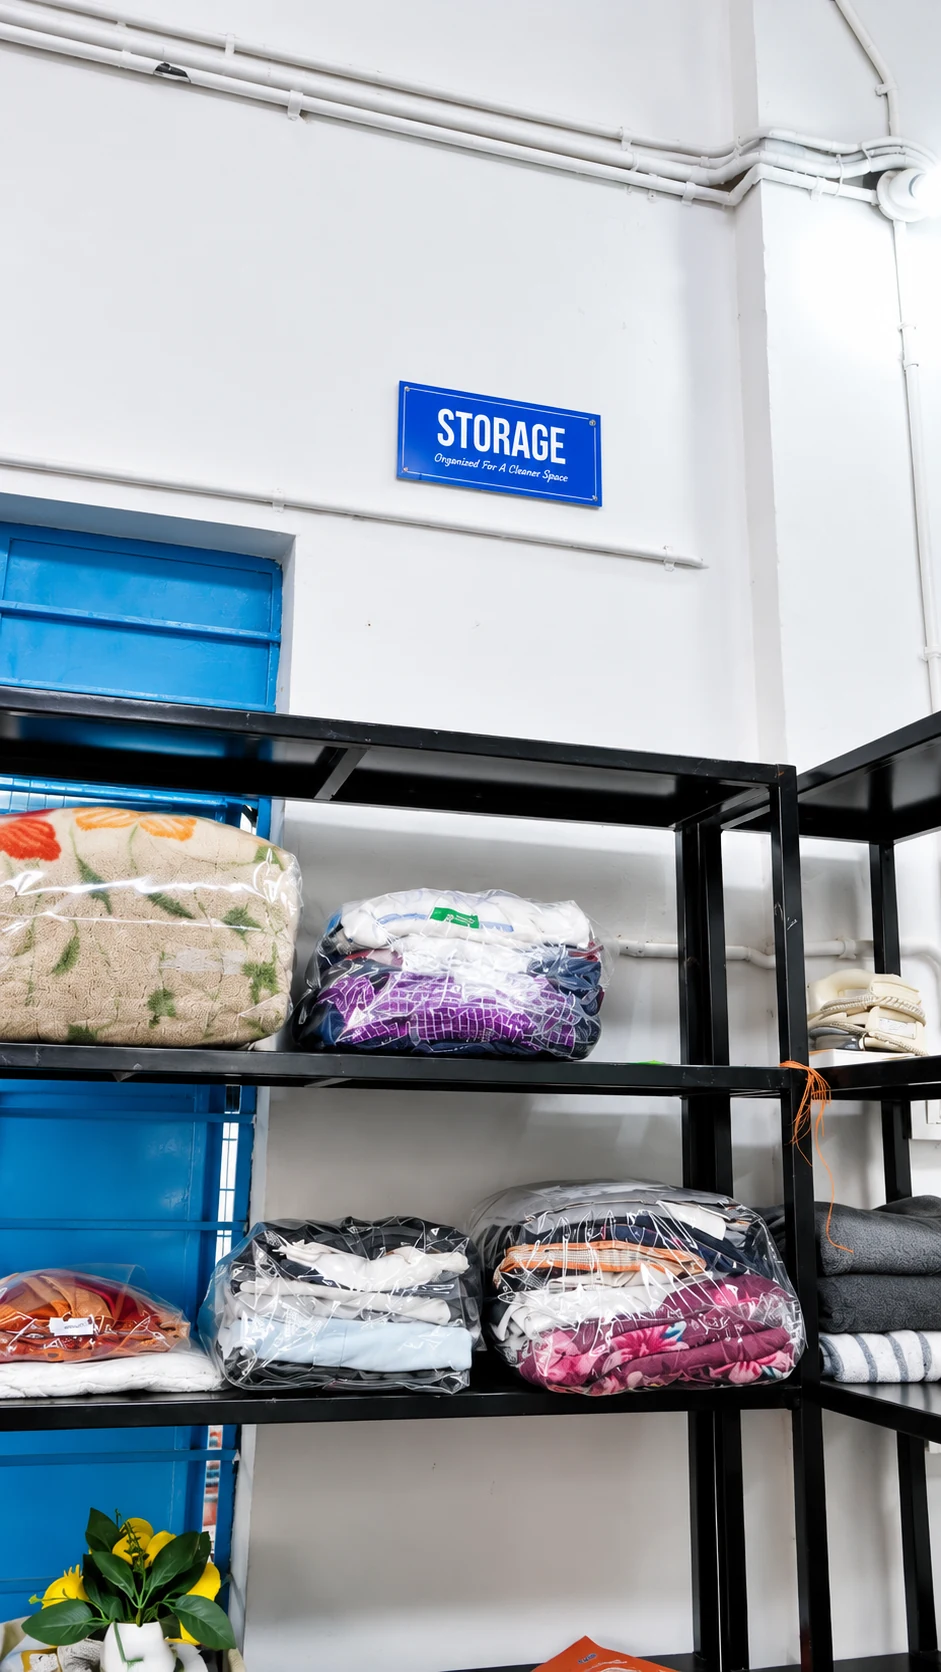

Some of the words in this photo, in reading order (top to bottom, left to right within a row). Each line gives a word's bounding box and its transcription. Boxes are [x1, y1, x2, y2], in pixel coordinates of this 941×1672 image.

[437, 408, 566, 464] STORAGE
[434, 453, 480, 468] Organized
[482, 460, 497, 471] For
[499, 463, 506, 473] A
[509, 465, 541, 478] Cleaner
[542, 470, 569, 483] Space
